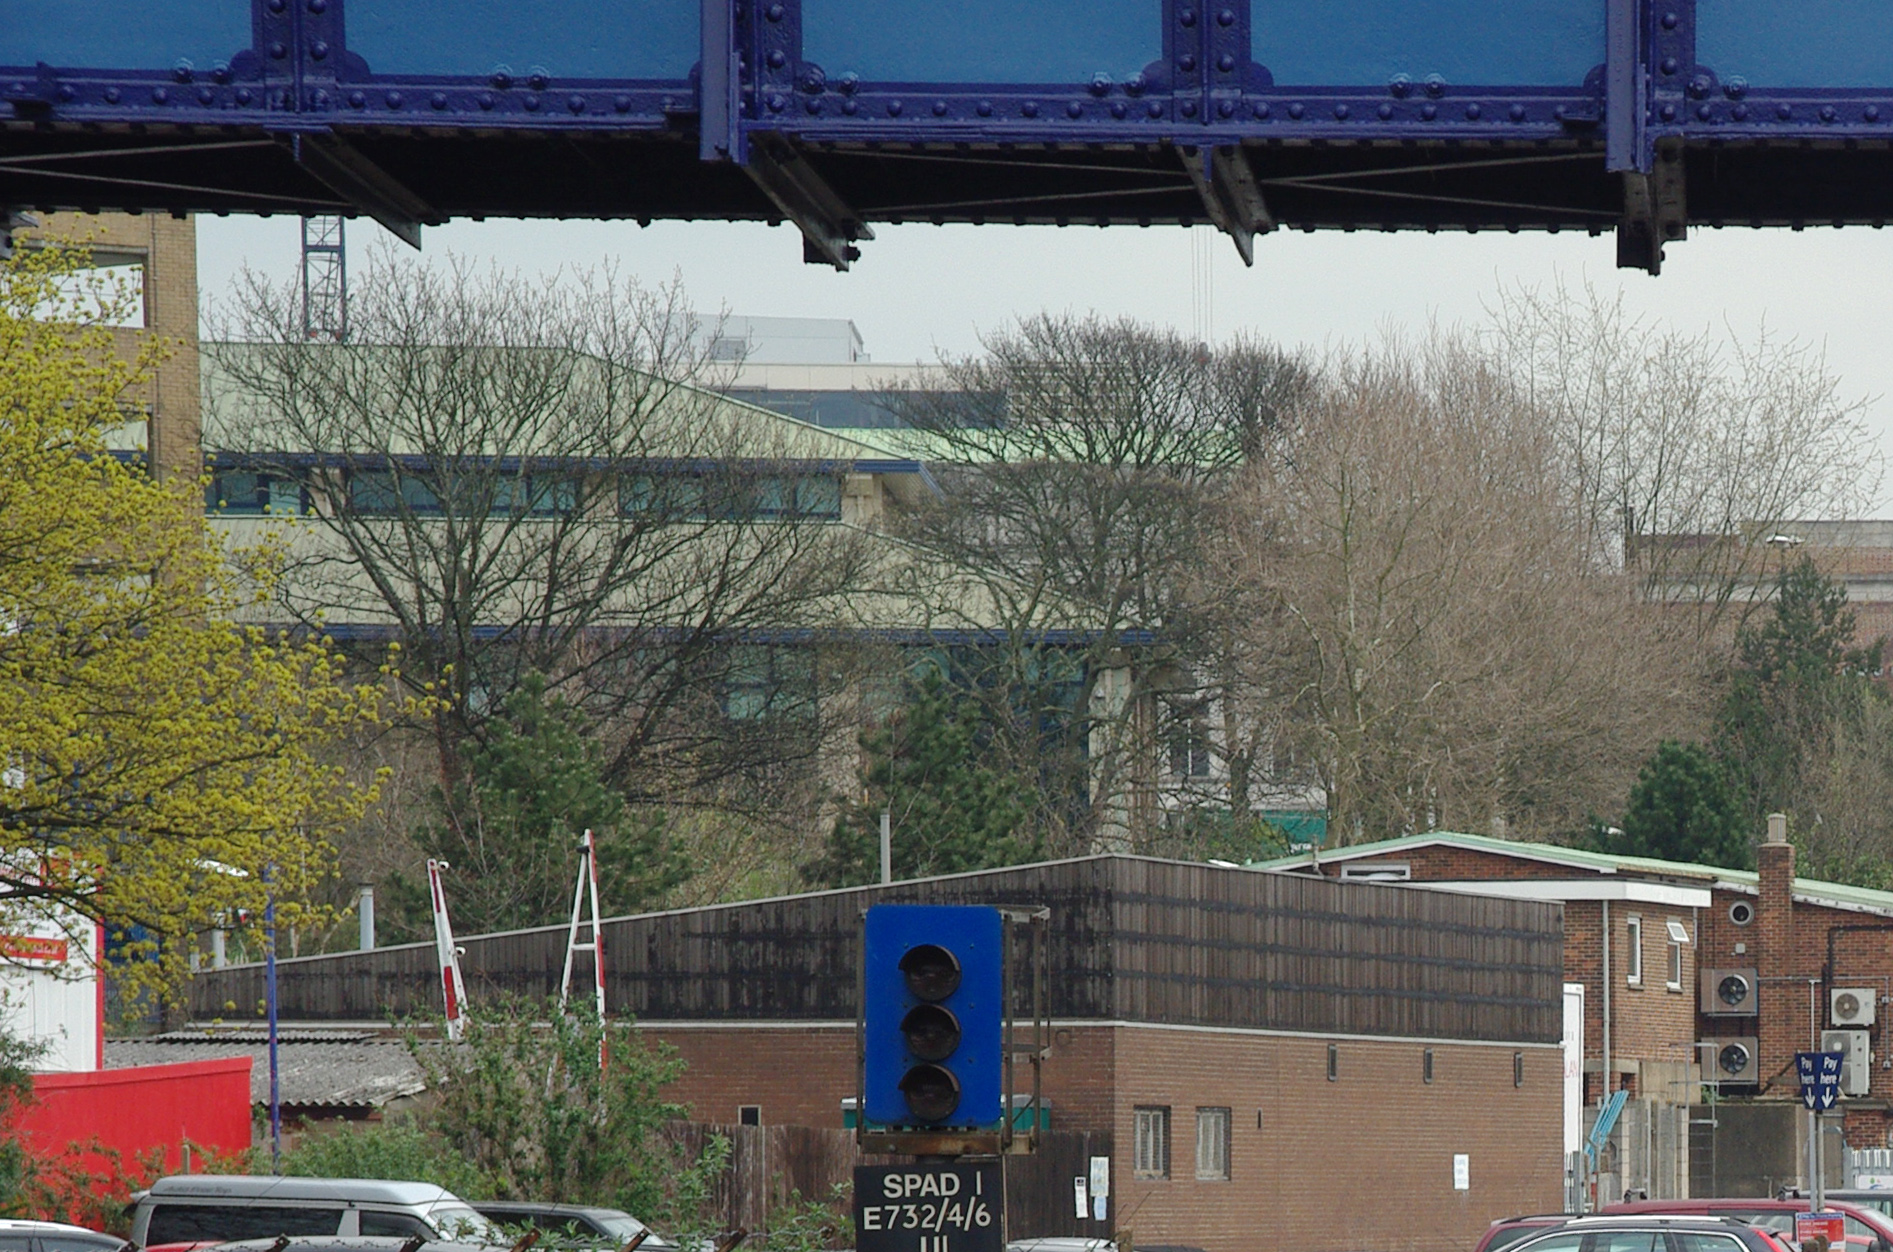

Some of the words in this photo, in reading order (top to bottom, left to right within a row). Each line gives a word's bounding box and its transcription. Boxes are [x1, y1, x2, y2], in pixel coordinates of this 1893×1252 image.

[1801, 1056, 1812, 1072] Pay
[1824, 1056, 1838, 1072] Pay
[1800, 1072, 1815, 1085] here
[1820, 1071, 1837, 1084] here
[883, 1172, 960, 1199] SPAD
[863, 1196, 991, 1233] E732/4/6
